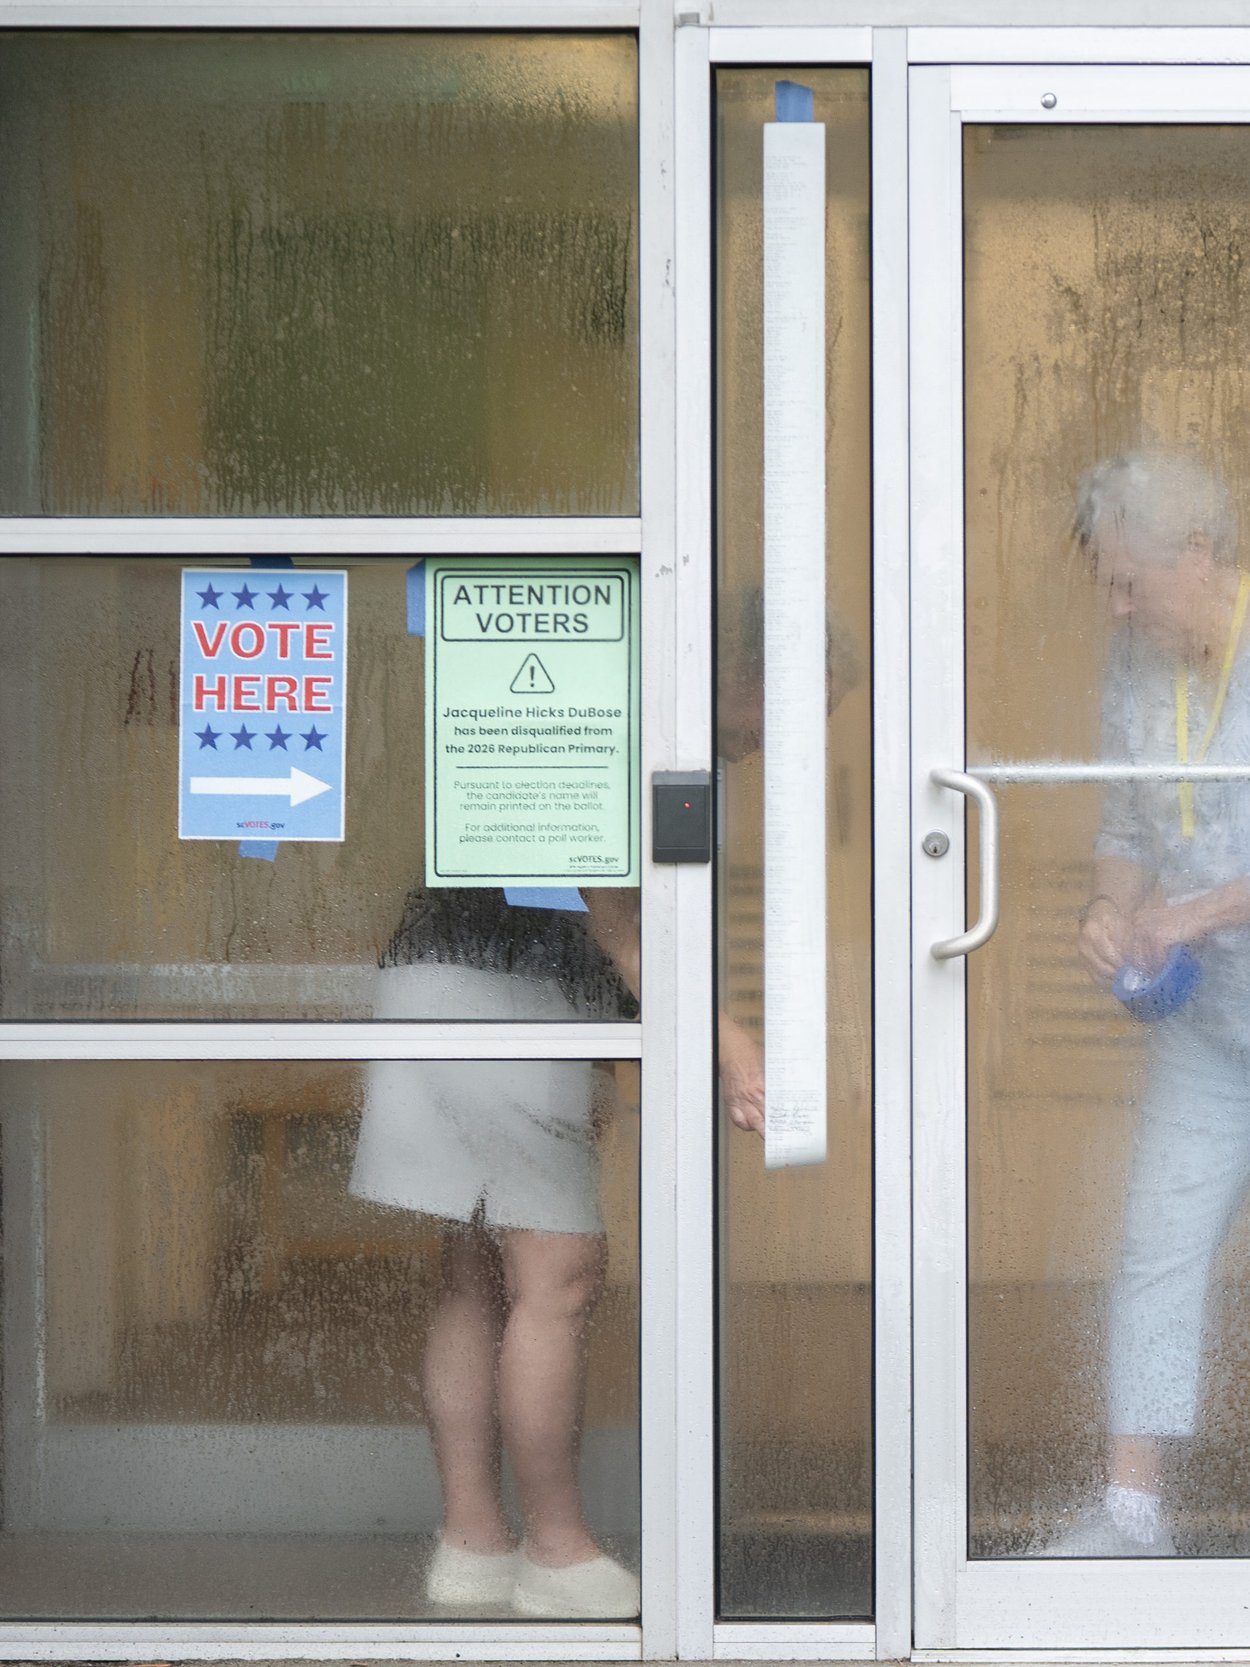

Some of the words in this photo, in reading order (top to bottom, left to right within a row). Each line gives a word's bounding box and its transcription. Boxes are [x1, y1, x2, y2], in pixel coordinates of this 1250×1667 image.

[453, 584, 611, 606] ATTENTION
[475, 612, 590, 634] VOTERS
[193, 622, 334, 659] VOTE
[193, 674, 333, 712] HERE
[443, 706, 522, 721] Jacqueline
[526, 706, 565, 718] Hicks
[568, 707, 622, 718] DuBose
[454, 726, 476, 736] has
[479, 726, 509, 736] been
[511, 725, 581, 738] disqualified
[584, 726, 613, 736] from
[445, 744, 465, 754] the
[467, 744, 494, 754] 2026
[498, 744, 566, 756] Republican
[568, 744, 619, 756] Primary.
[454, 780, 499, 789] Pursuant
[502, 780, 512, 789] to
[514, 780, 556, 789] election
[558, 780, 611, 790] deadlines,
[466, 791, 483, 800] the
[485, 791, 547, 800] candidate's
[549, 792, 579, 800] name
[582, 791, 598, 800] will
[460, 802, 497, 811] remain
[499, 802, 536, 813] printed
[539, 803, 552, 811] on
[555, 802, 571, 811] the
[465, 823, 480, 832] For
[483, 823, 535, 832] additional
[538, 823, 600, 833] information,
[459, 833, 494, 844] please
[496, 834, 536, 843] contact
[548, 833, 567, 845] poll
[569, 834, 606, 843] worker.
[568, 855, 620, 864] scVOTES.gov
